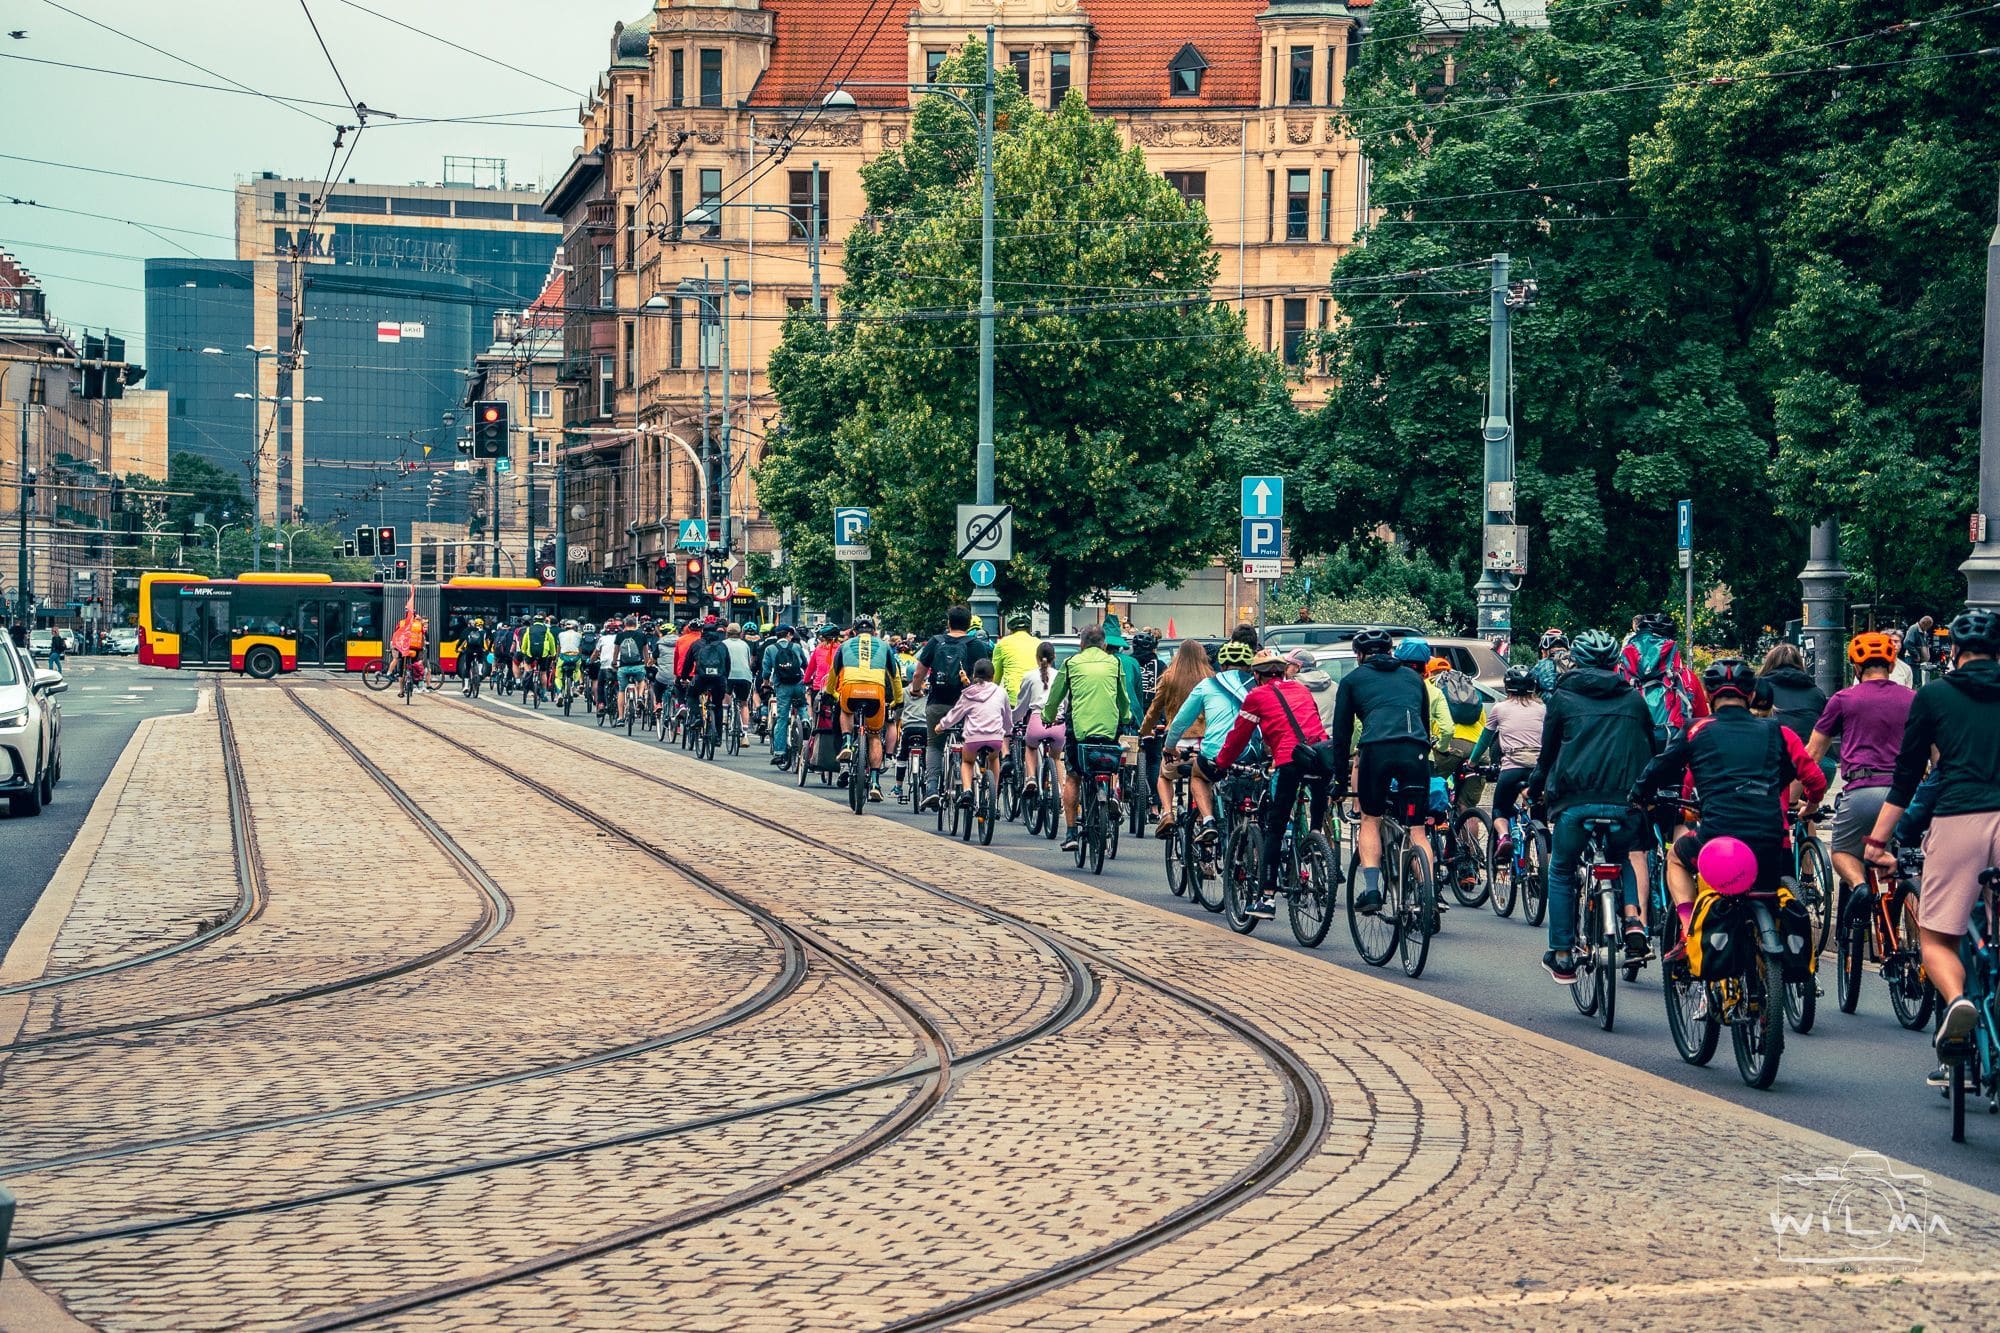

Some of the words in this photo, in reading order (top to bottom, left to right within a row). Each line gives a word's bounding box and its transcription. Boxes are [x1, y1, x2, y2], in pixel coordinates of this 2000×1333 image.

[1681, 505, 1687, 534] P
[1252, 522, 1273, 553] P
[544, 569, 556, 577] 30
